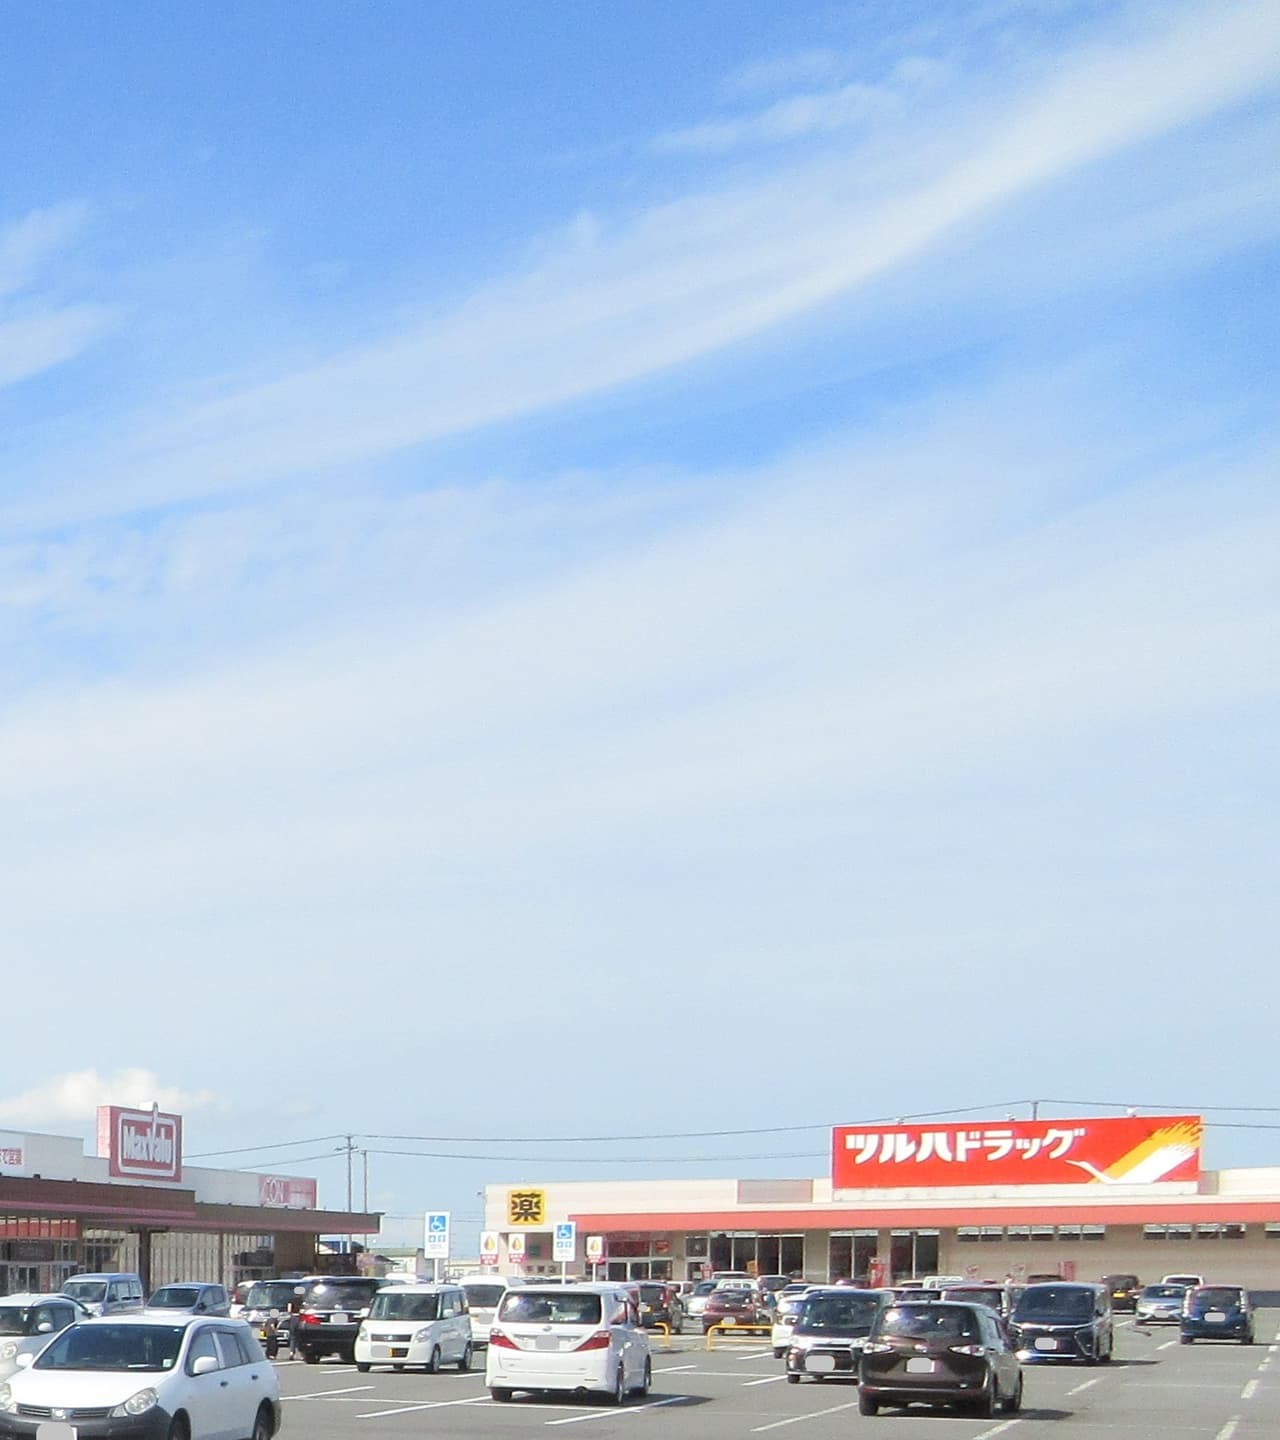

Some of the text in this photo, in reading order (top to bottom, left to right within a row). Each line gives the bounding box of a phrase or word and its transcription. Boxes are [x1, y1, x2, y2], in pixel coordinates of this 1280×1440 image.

[844, 1128, 1087, 1165] ツルハドラッグ
[511, 1192, 542, 1223] 薬
